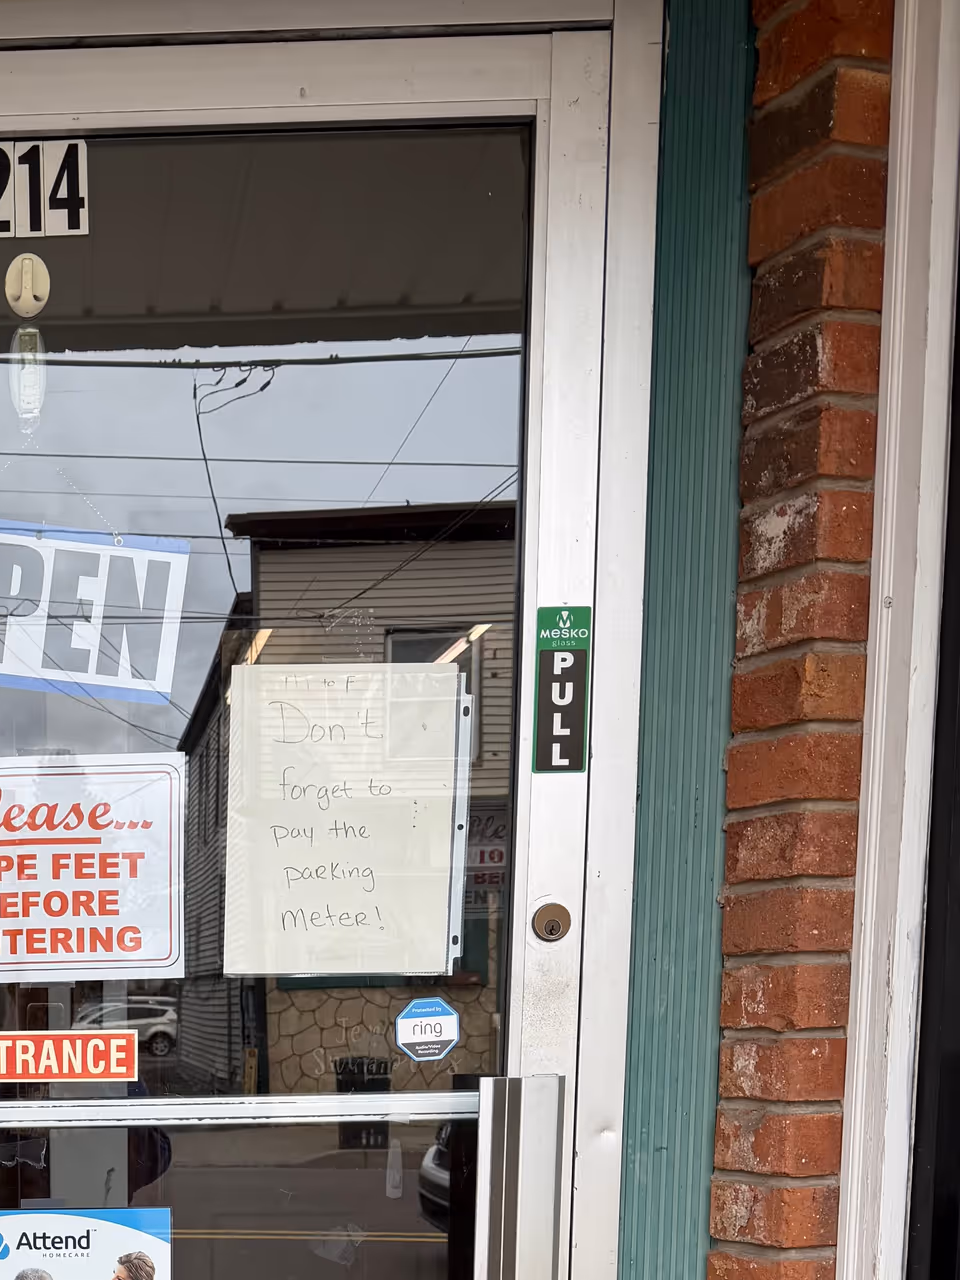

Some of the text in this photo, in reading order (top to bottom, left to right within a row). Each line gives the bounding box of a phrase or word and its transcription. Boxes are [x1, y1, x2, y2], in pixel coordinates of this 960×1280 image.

[323, 678, 336, 688] to
[345, 673, 357, 692] F
[268, 700, 384, 744] Don't
[551, 652, 574, 766] PULL
[279, 766, 392, 811] forget to
[269, 819, 371, 848] pay the
[51, 852, 145, 880] FEET
[412, 1021, 442, 1037] ring
[16, 1229, 90, 1250] Attend
